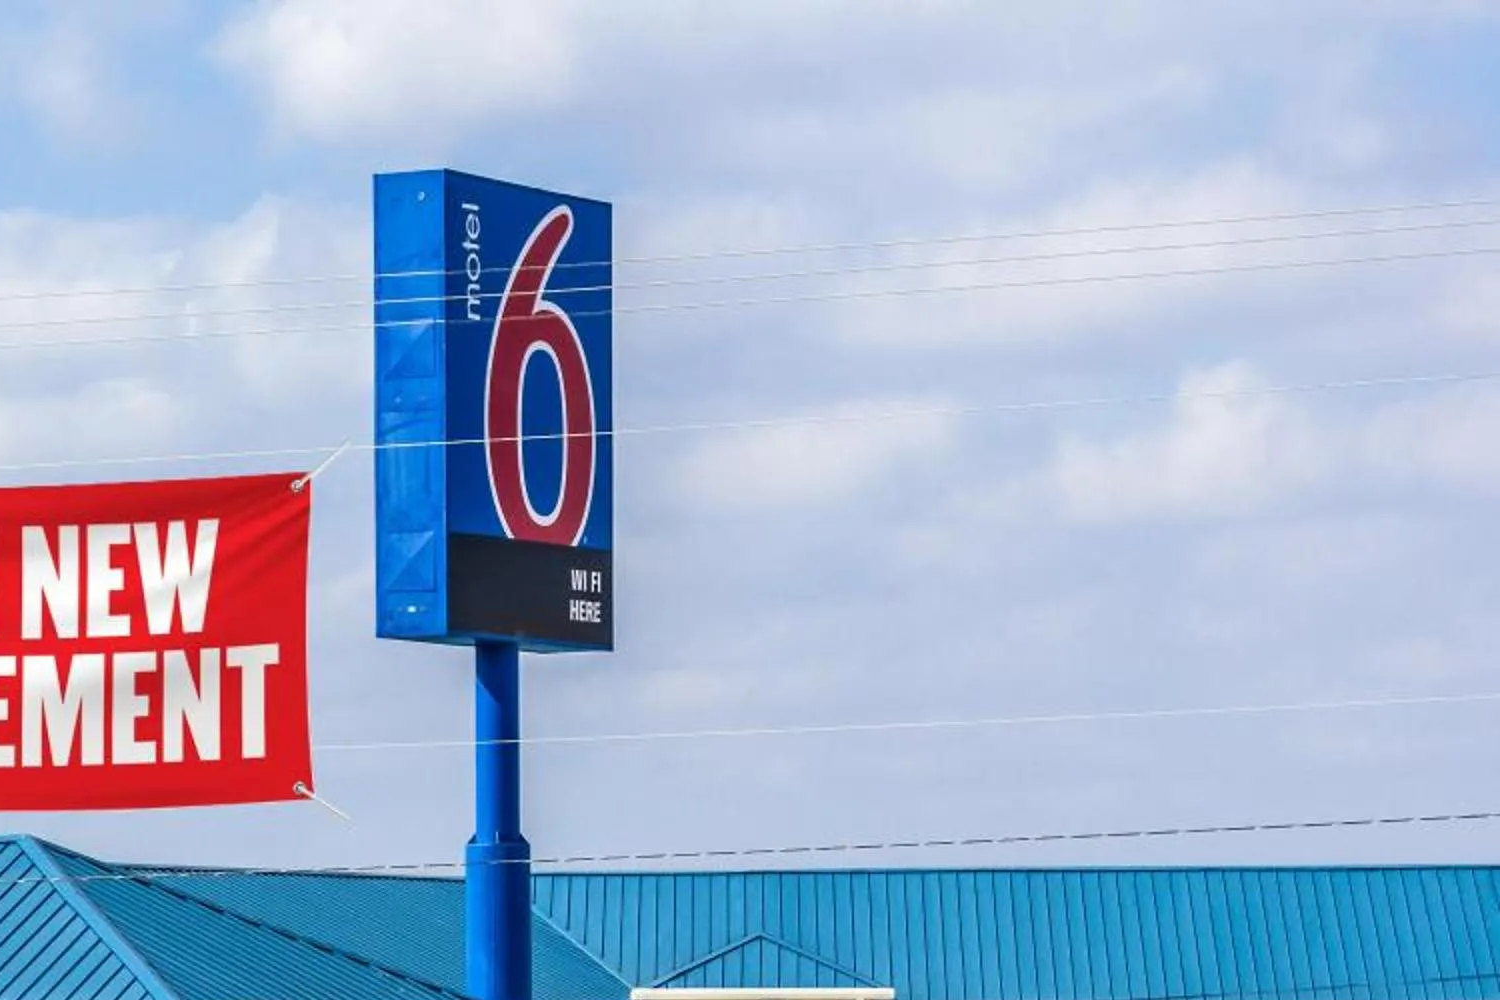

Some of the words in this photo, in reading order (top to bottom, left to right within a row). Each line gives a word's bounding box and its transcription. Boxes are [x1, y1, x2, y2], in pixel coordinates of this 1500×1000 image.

[461, 202, 481, 321] motel
[484, 204, 596, 548] 6
[21, 518, 220, 640] NEW
[569, 599, 601, 623] HERE
[571, 569, 587, 593] WI
[591, 571, 602, 593] FI
